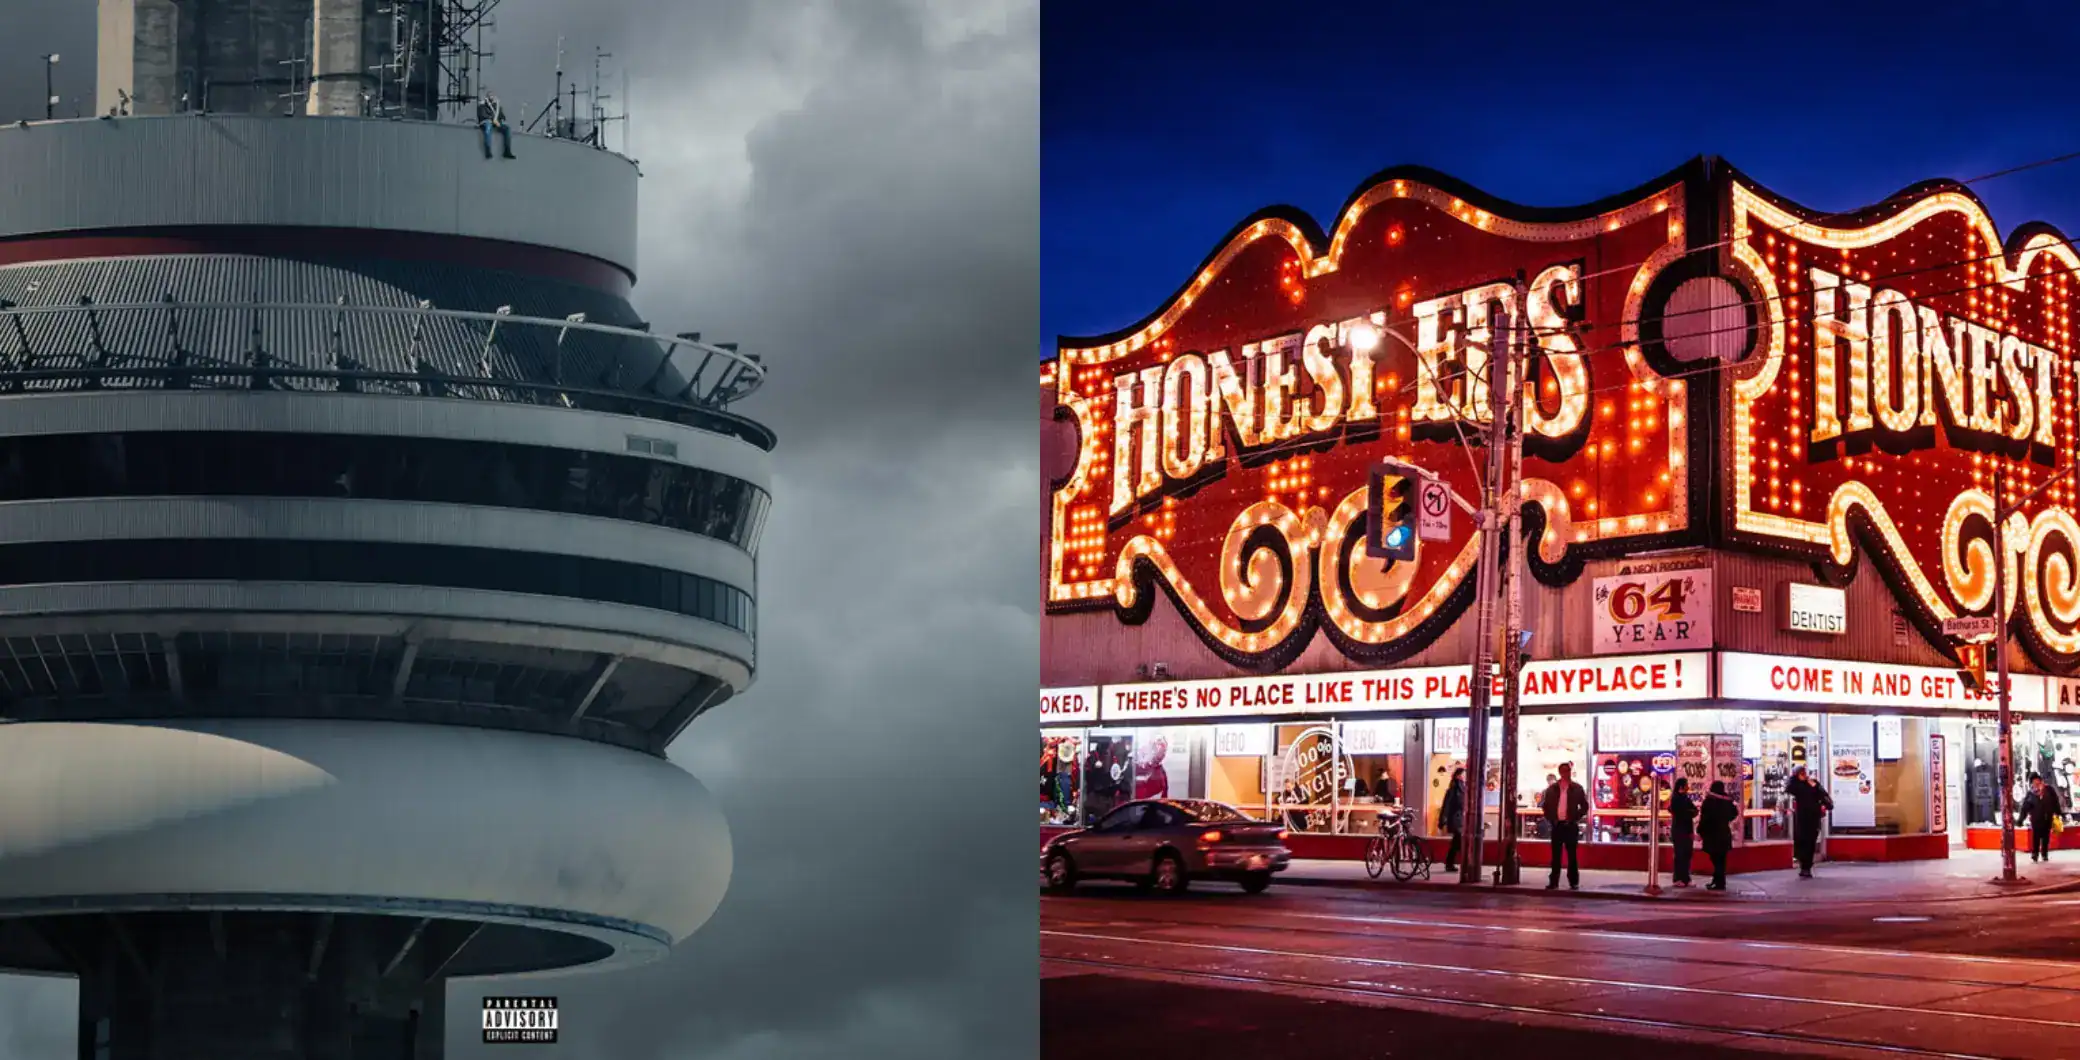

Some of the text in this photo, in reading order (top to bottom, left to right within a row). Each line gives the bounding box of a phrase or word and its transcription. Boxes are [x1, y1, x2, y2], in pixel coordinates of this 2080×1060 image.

[1810, 267, 2059, 447] HONEST
[1109, 312, 1387, 516] HONEST
[1792, 610, 1843, 631] DENTIST
[1946, 617, 1990, 631] Bathurst St
[1116, 687, 1188, 711] THERE'S
[1196, 687, 1221, 708] NO
[1230, 684, 1294, 706] PLACE
[1306, 681, 1353, 704] LIKE
[1362, 678, 1414, 702] THIS
[1425, 674, 1505, 699] PLAE
[1771, 665, 1833, 693] COME
[1843, 670, 1862, 695] IN
[1872, 673, 1911, 697] AND
[1921, 676, 1955, 698] GET
